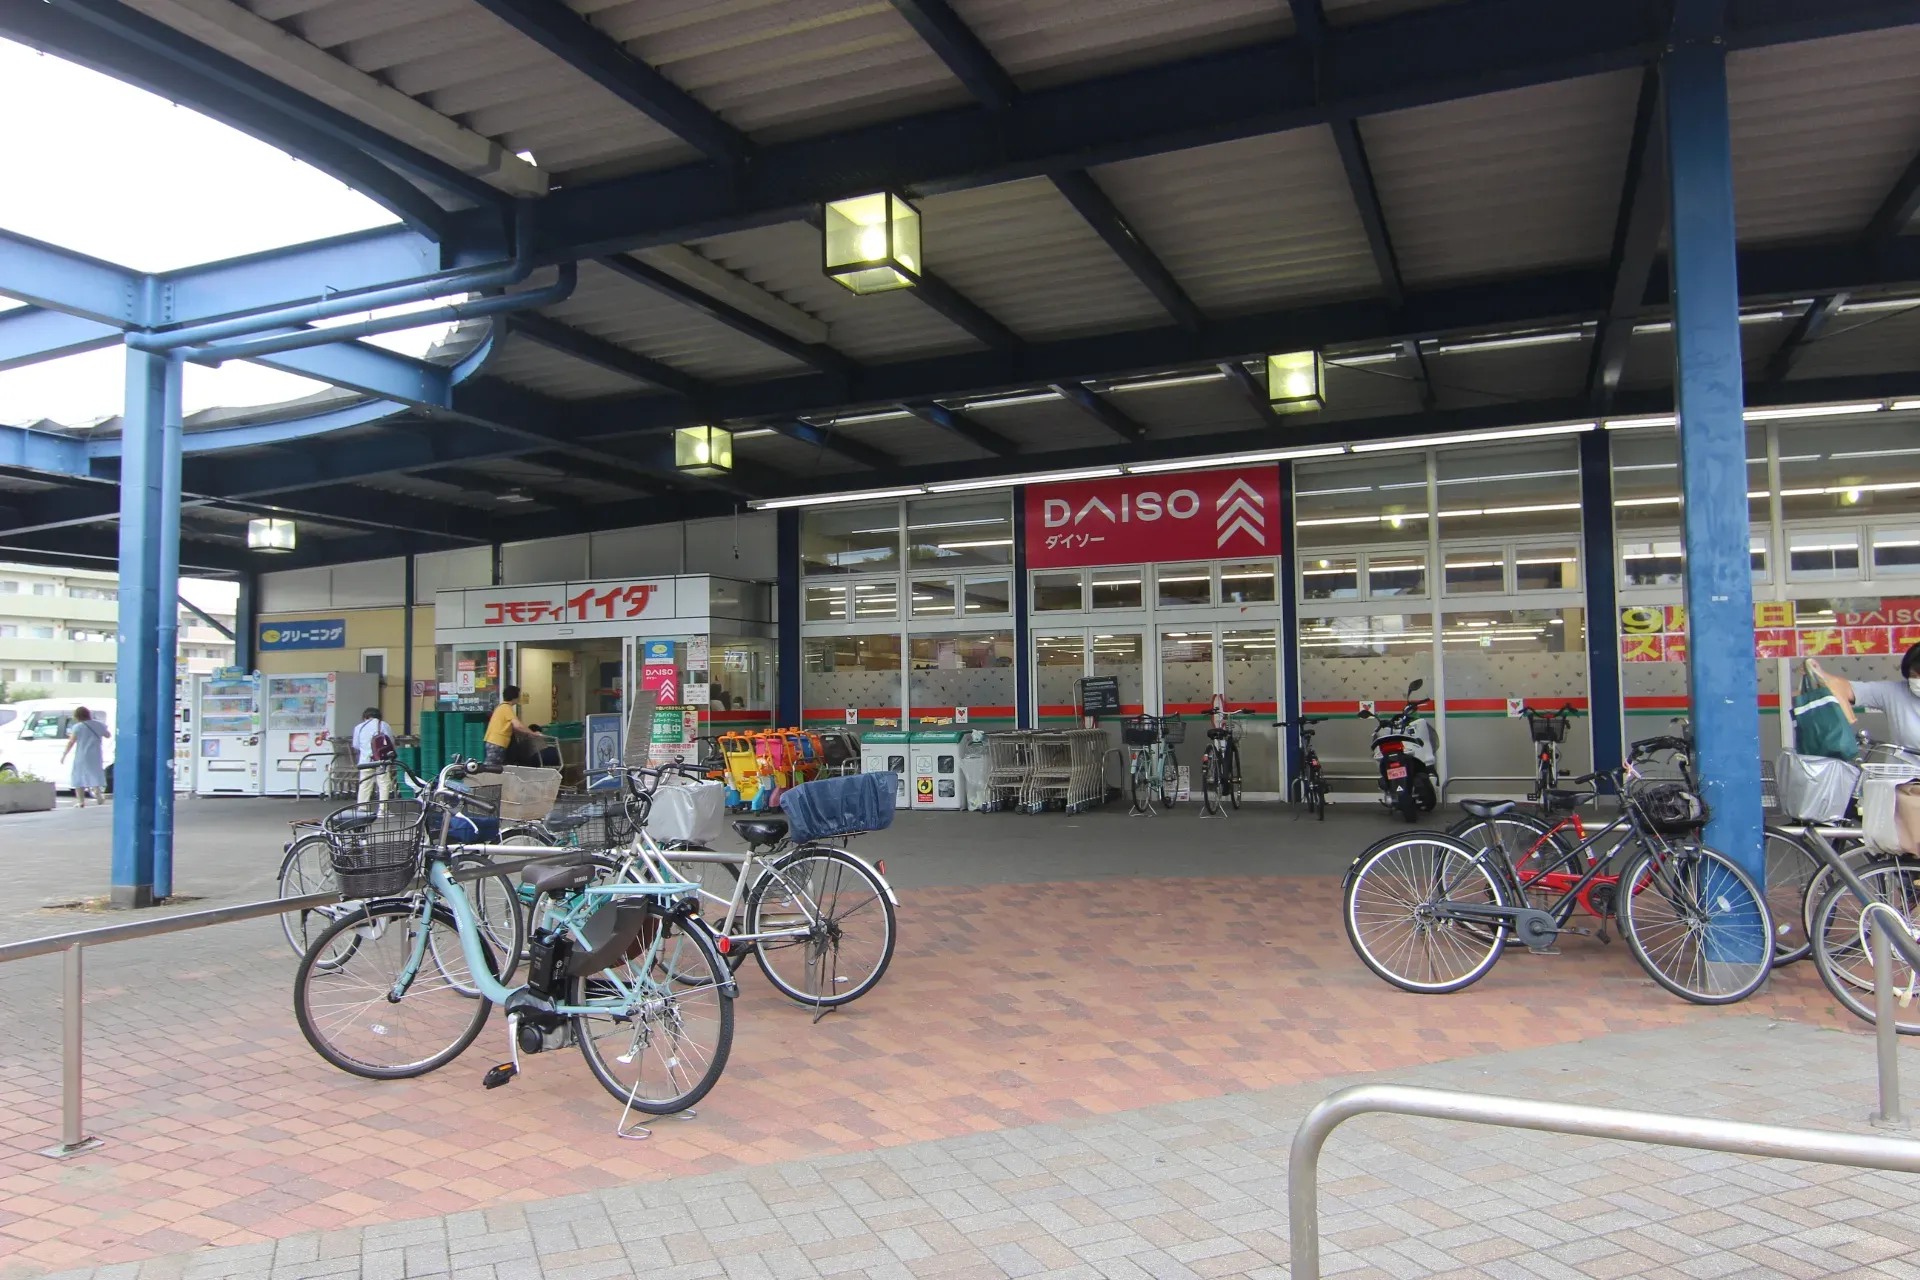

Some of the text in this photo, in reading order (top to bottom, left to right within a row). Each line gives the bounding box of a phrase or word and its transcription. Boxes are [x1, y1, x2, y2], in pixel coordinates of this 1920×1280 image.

[1044, 489, 1200, 528] DAISO
[1045, 533, 1105, 549] ダイソー
[281, 627, 343, 642] クリーニング
[645, 668, 674, 676] DAISO
